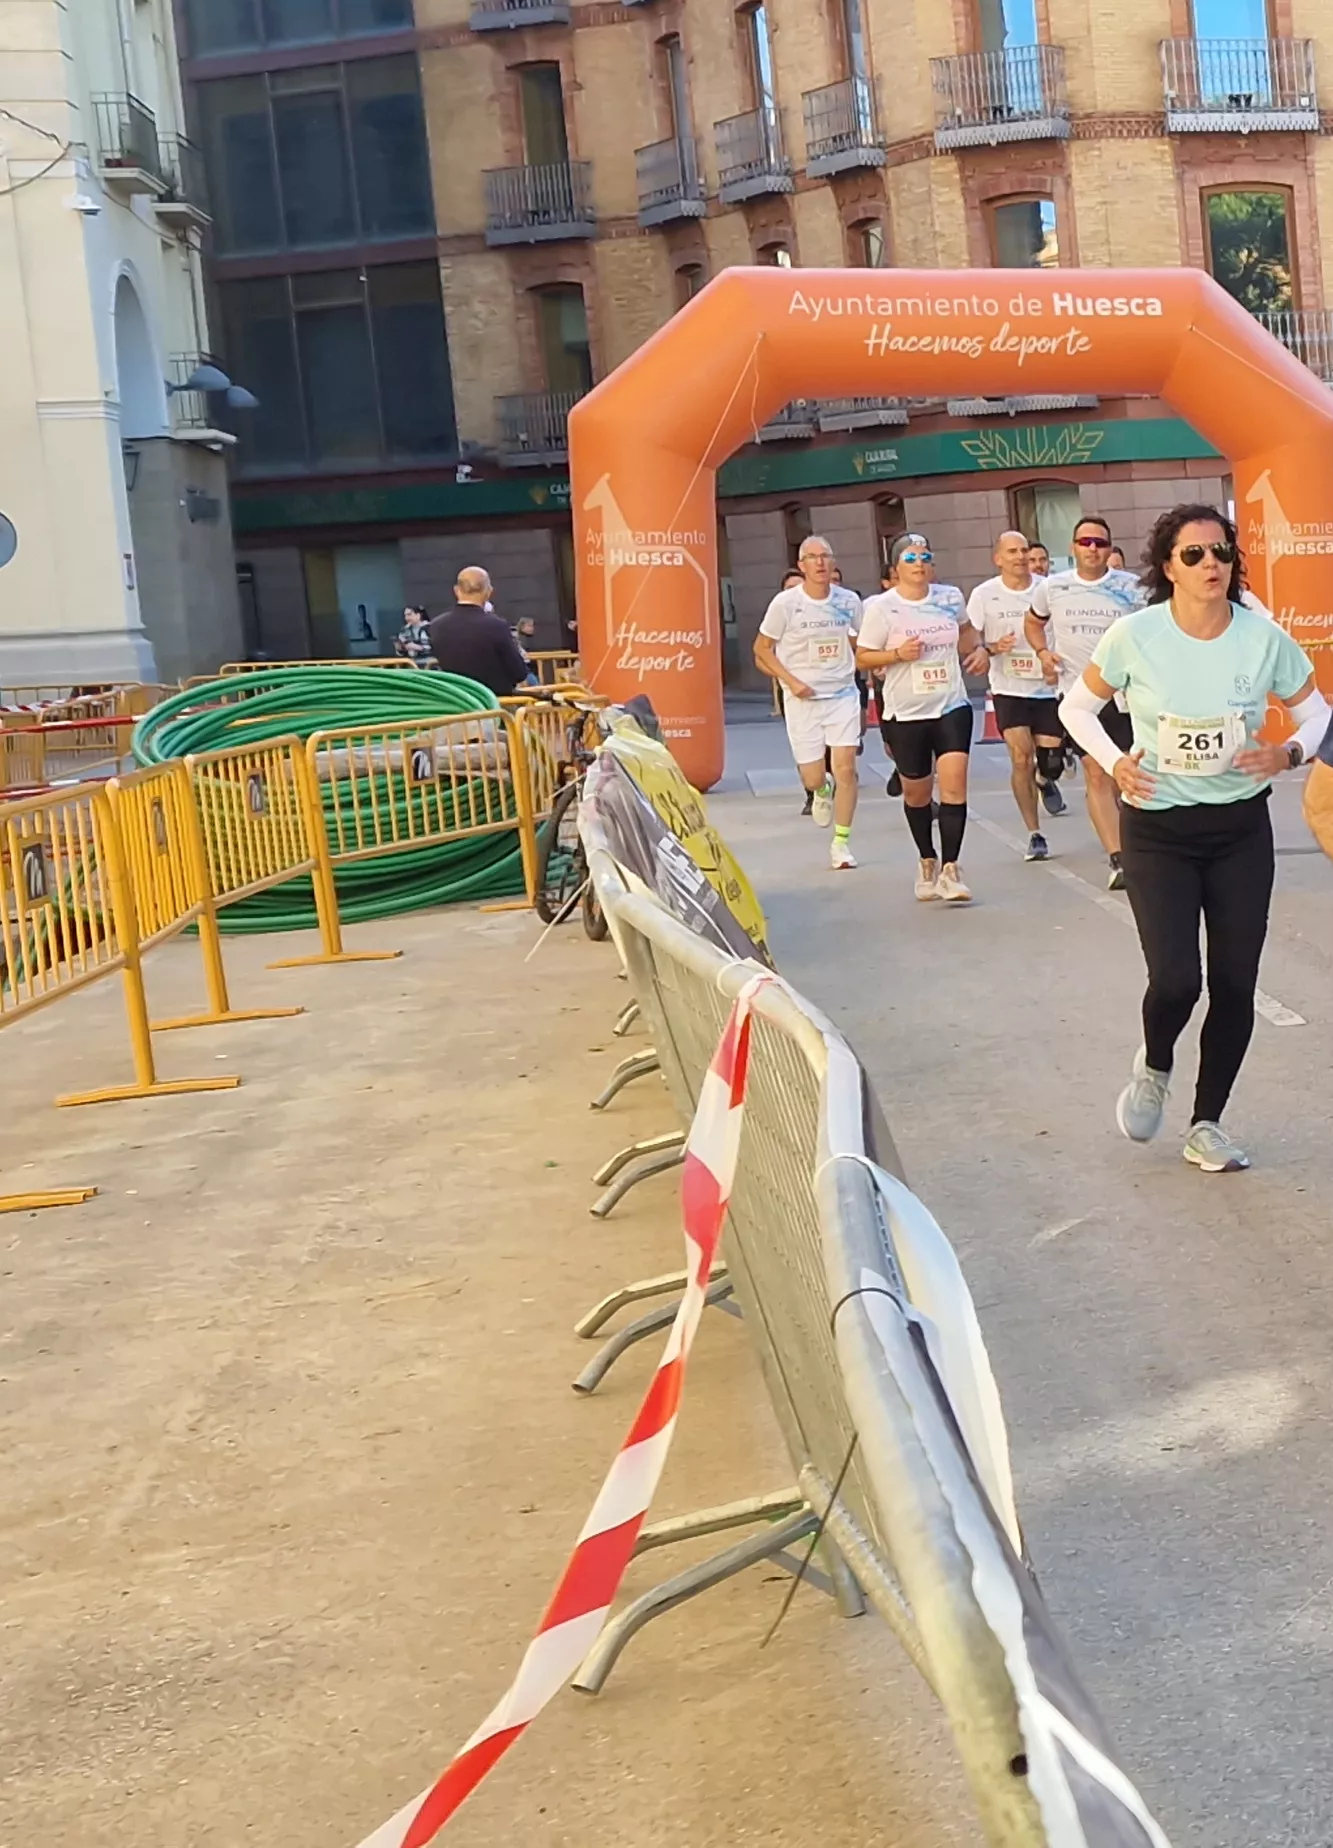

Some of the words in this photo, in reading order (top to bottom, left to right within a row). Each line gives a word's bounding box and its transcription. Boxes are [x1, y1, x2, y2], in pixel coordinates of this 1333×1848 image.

[788, 291, 999, 322] Ayuntamiento
[1009, 292, 1043, 317] de
[1052, 292, 1163, 317] Huesca
[864, 322, 985, 358] Hacemos
[989, 322, 1093, 367] deporte
[585, 528, 706, 548] Ayuntamiento
[1249, 540, 1266, 555] de
[587, 550, 604, 566] de
[609, 549, 684, 566] Huesca
[614, 621, 704, 648] Hacemos
[616, 647, 696, 683] deporte
[1177, 731, 1224, 751] 261
[1185, 752, 1220, 761] ELISA
